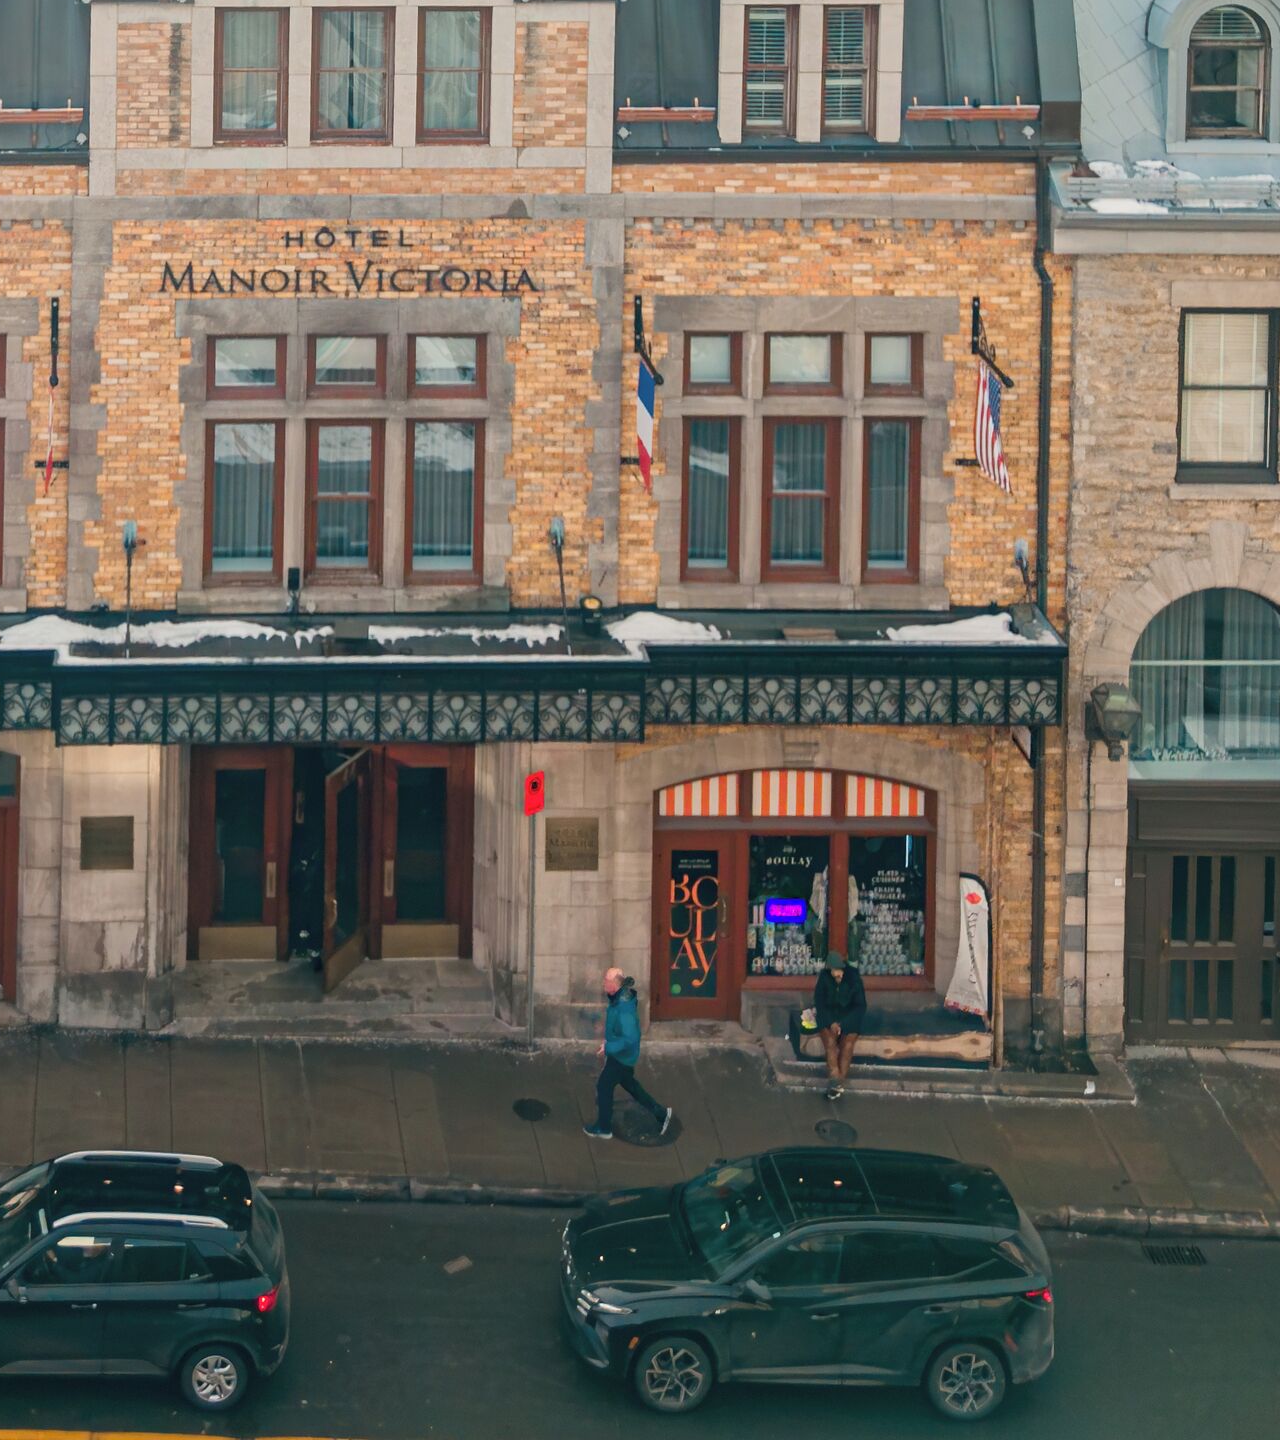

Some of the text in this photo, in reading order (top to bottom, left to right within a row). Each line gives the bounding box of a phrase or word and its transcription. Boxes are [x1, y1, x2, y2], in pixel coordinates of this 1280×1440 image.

[283, 226, 415, 248] HÔTEL
[160, 260, 539, 293] MANOIR VICTORIA
